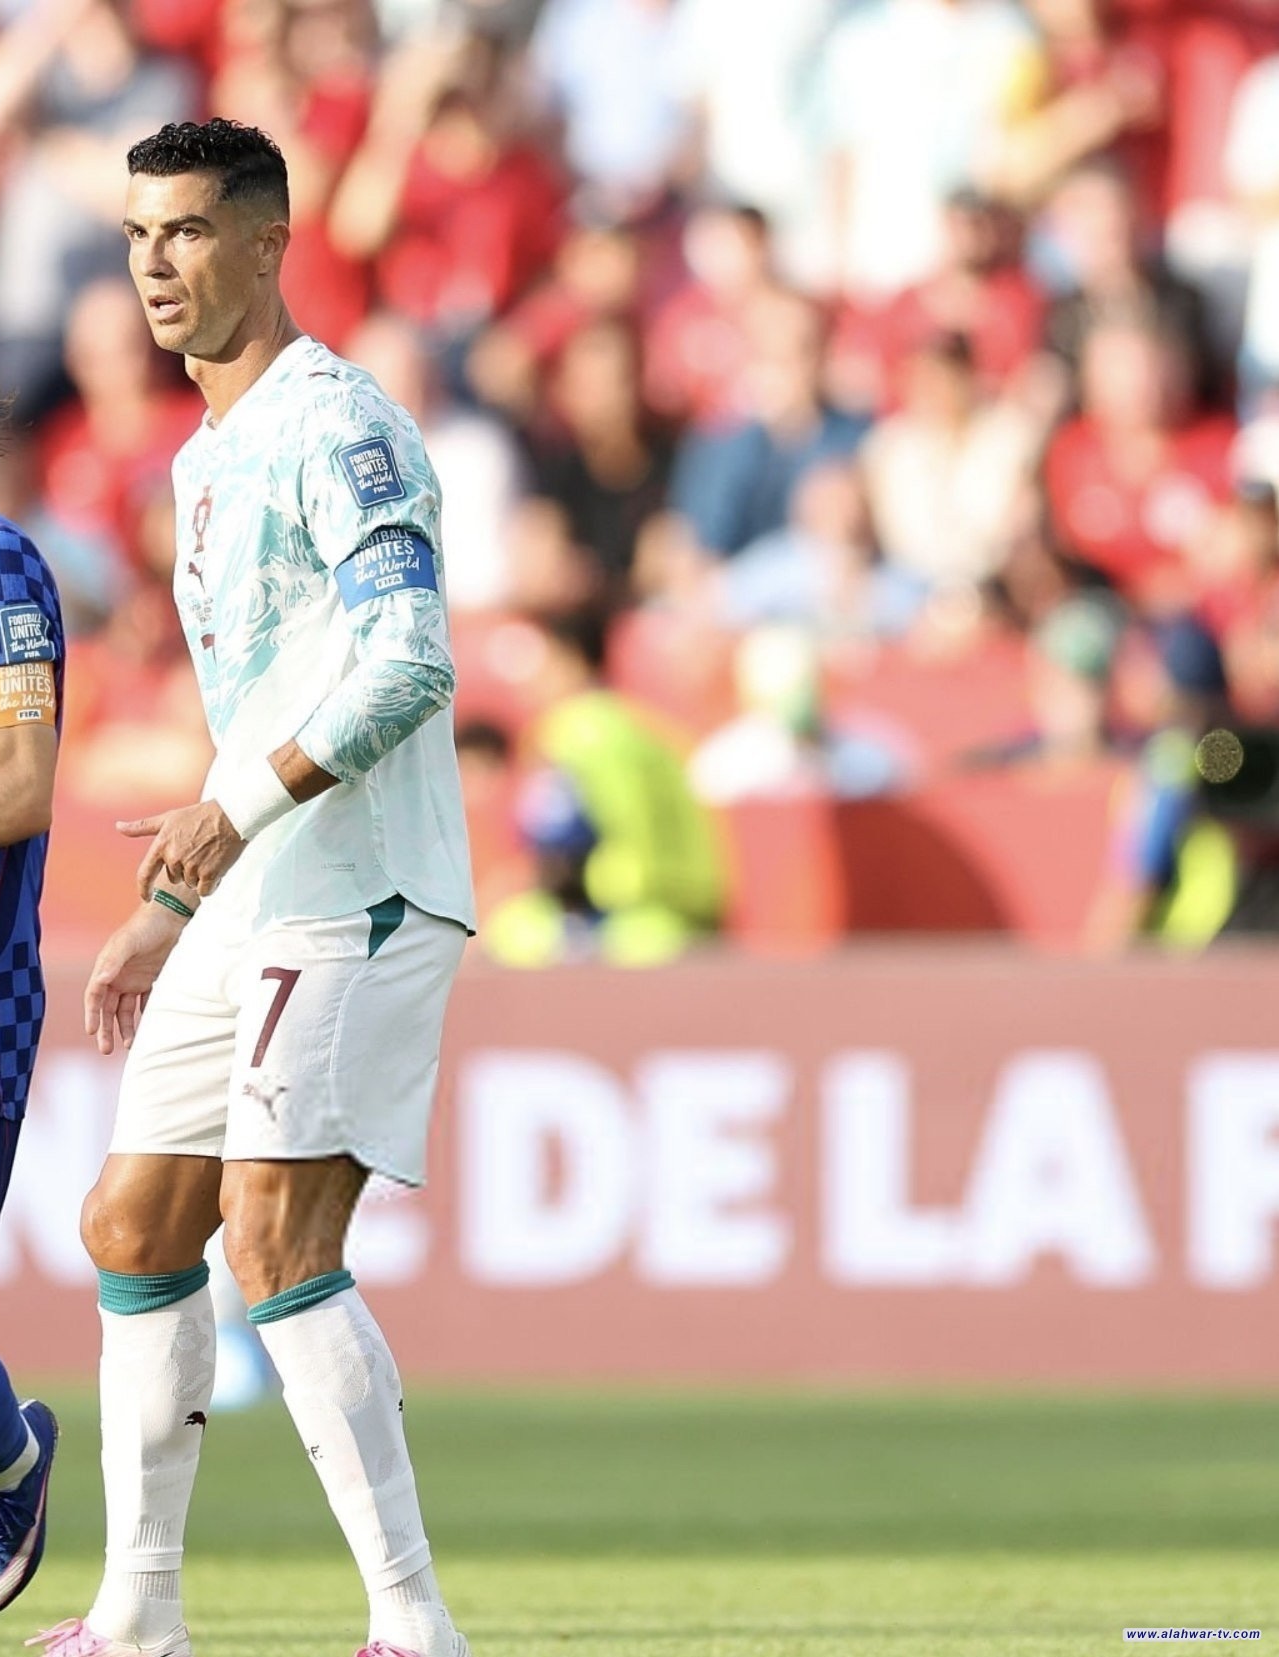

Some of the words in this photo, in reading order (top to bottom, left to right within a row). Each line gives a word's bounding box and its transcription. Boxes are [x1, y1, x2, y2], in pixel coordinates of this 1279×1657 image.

[349, 447, 385, 466] FOOTBALL
[353, 457, 389, 478] UNITES
[357, 477, 373, 490] the
[354, 539, 415, 568] UNITES
[354, 567, 377, 585] the
[378, 555, 420, 576] World
[378, 575, 401, 588] FIFA
[10, 640, 26, 653] the
[0, 662, 50, 679] FOOTBALL
[0, 676, 51, 695] UNITES
[19, 710, 40, 719] FIFA
[250, 966, 303, 1068] 7
[460, 1050, 788, 1290] DE
[820, 1050, 1160, 1291] LA
